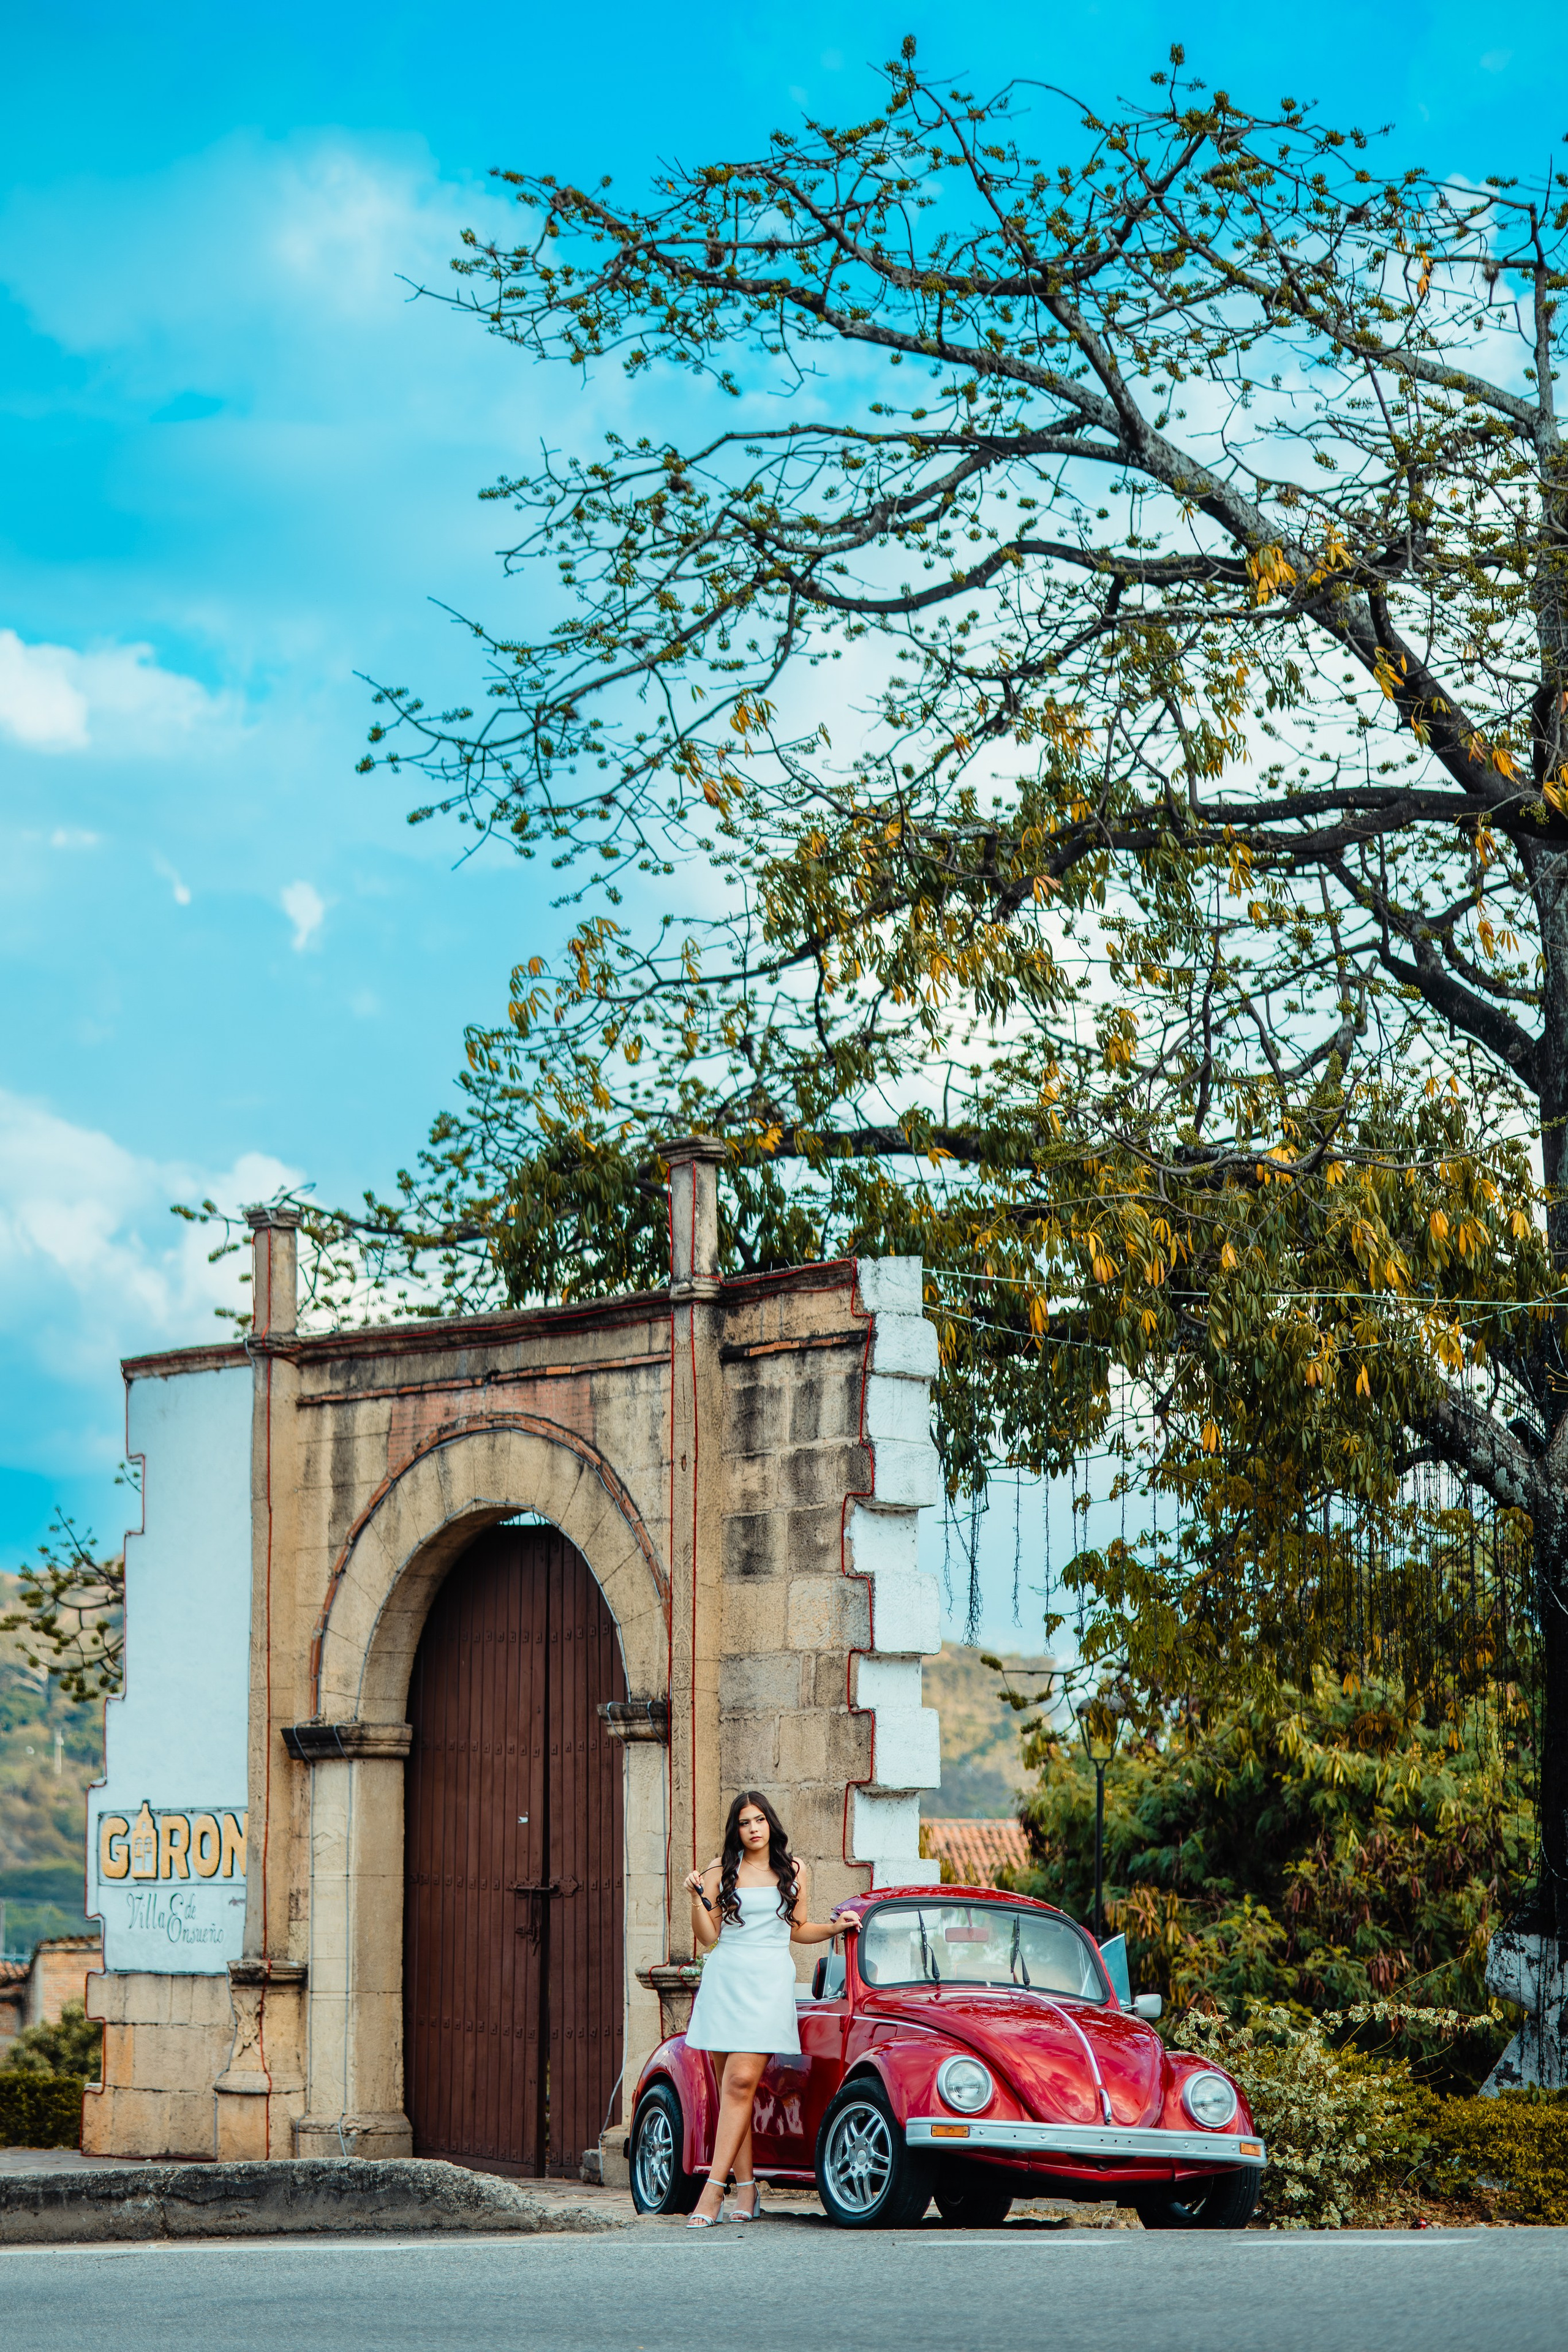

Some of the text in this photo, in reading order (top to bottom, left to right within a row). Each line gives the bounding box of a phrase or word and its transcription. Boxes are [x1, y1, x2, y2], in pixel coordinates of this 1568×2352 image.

[127, 1893, 197, 1929] Villa de
[167, 1893, 224, 1943] Ensueño
